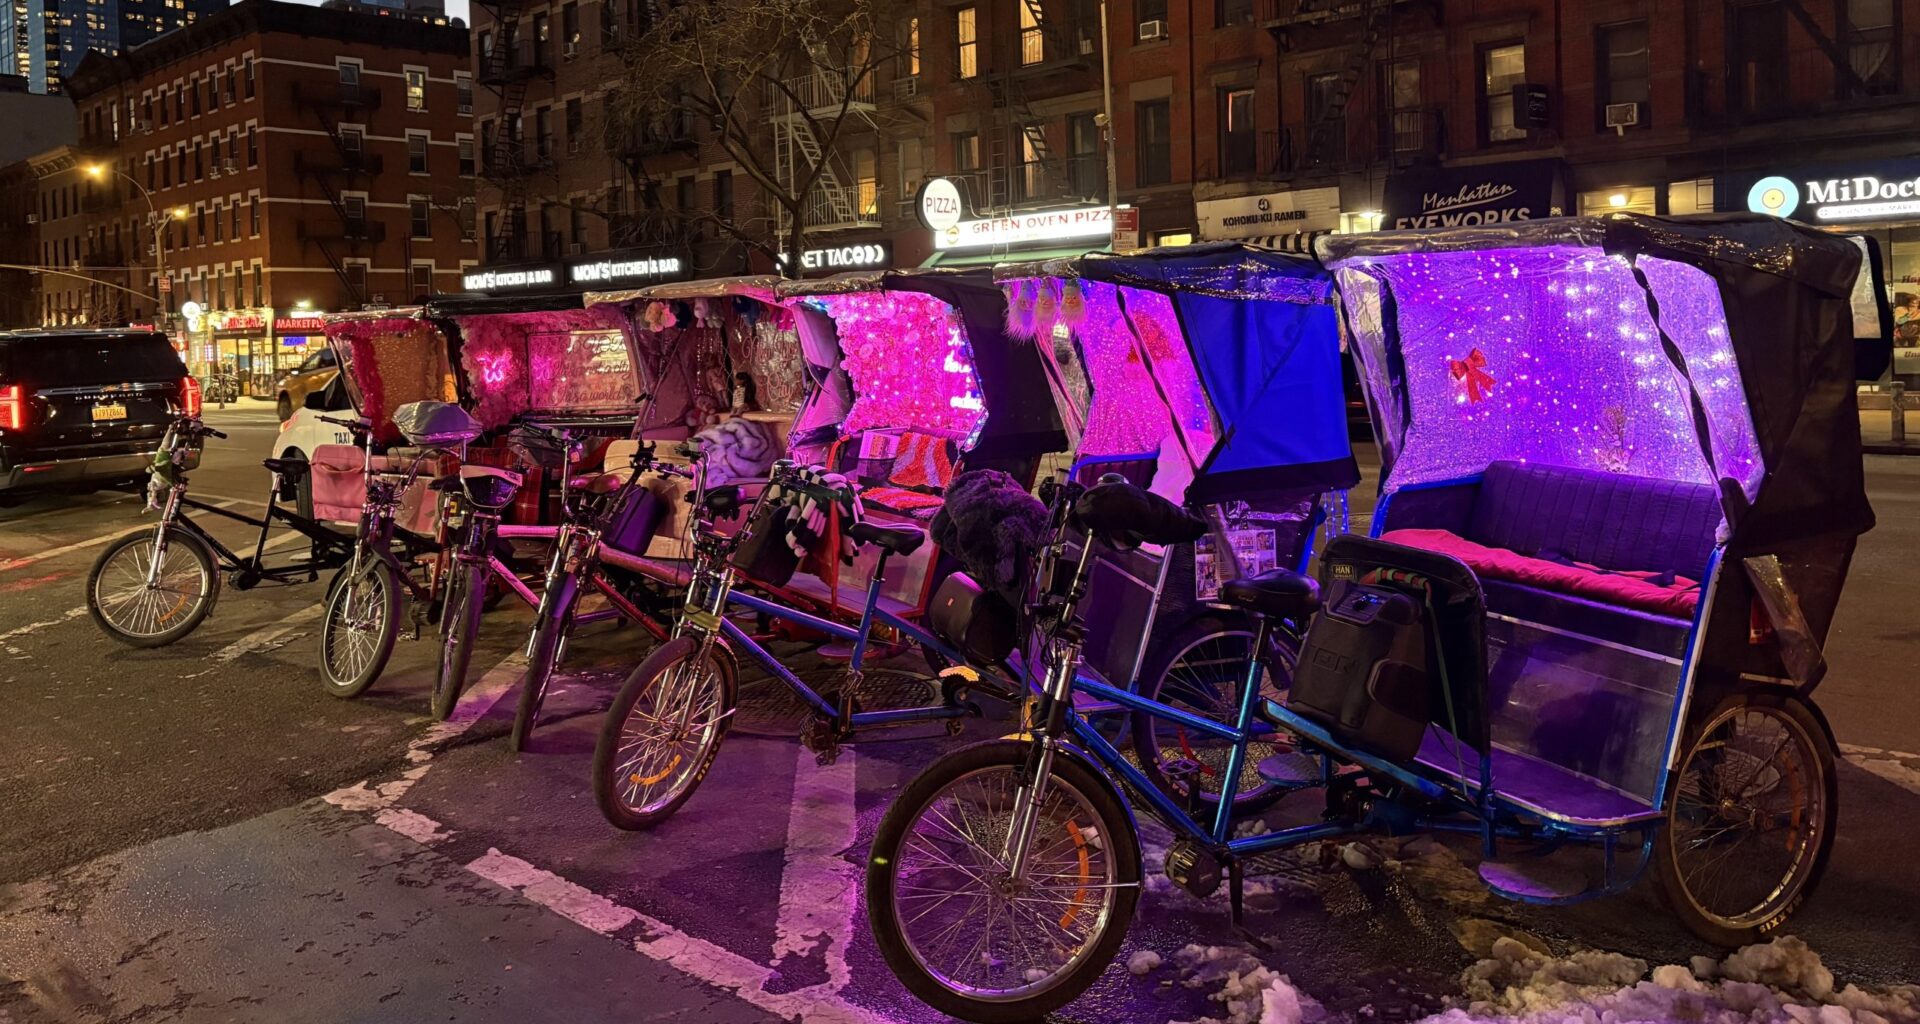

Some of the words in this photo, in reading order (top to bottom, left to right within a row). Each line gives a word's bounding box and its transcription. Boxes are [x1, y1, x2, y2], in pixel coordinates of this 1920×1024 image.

[926, 197, 958, 213] PIZZA
[1423, 182, 1513, 211] Manhattan
[973, 219, 1020, 234] GREEN
[1026, 214, 1068, 228] OVEN
[1075, 209, 1111, 222] PIZZ
[1222, 212, 1272, 227] KOHOKU-KU
[1274, 210, 1306, 222] RAMEN
[1395, 207, 1531, 230] EYEWORKS
[465, 272, 494, 289] MOM'S
[495, 271, 526, 286] KITCHEN
[535, 269, 552, 283] BAR
[573, 262, 610, 281] MOM'S
[611, 260, 649, 277] KITCHEN
[651, 259, 659, 274] &
[659, 258, 679, 273] BAR
[334, 431, 350, 444] TAXI
